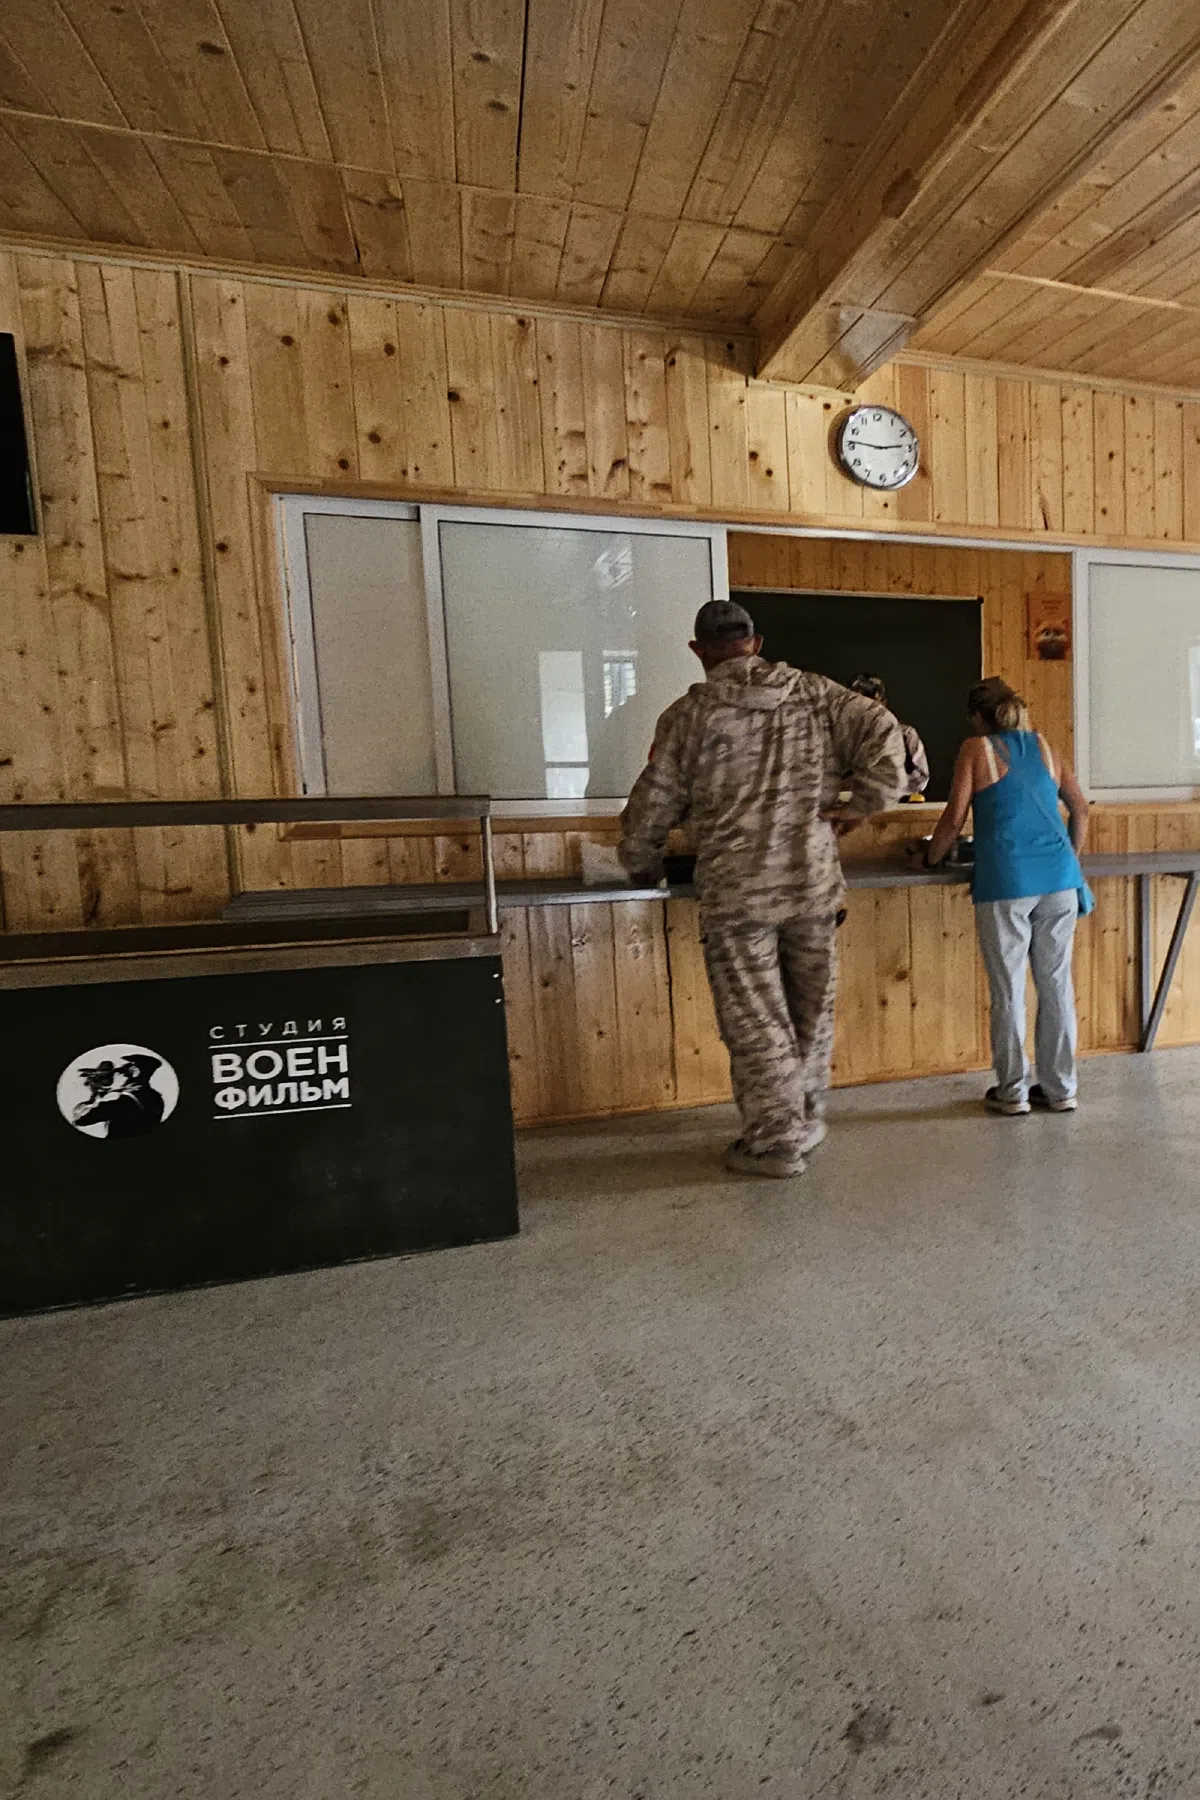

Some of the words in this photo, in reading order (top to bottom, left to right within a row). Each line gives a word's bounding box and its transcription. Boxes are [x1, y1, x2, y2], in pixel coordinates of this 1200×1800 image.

[860, 417, 868, 425] 11
[872, 413, 883, 422] 12
[208, 1016, 347, 1040] СТУДИЯ
[211, 1044, 349, 1084] ВОЕН
[213, 1076, 350, 1111] ФИЛЬМ
